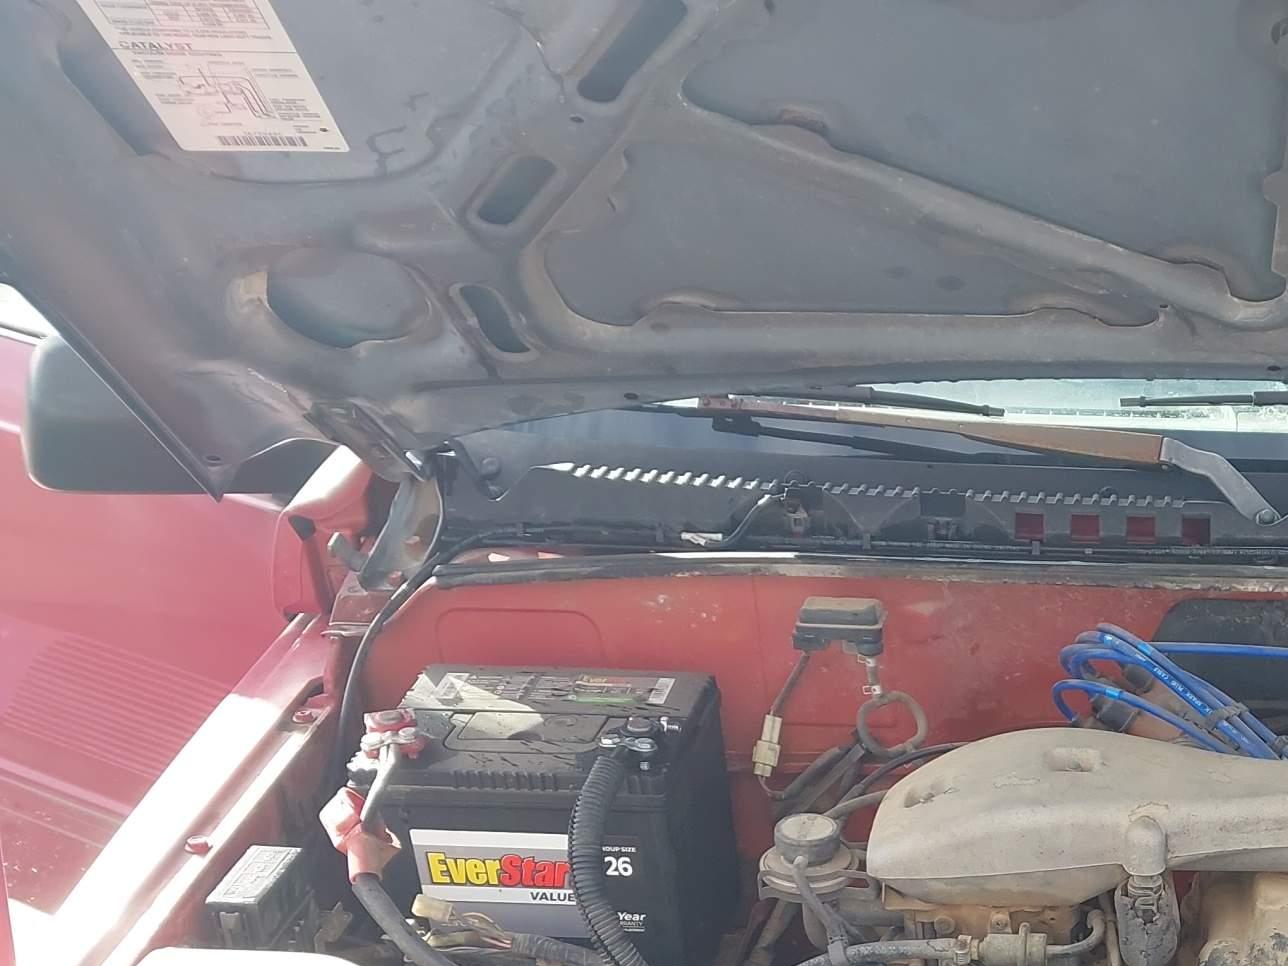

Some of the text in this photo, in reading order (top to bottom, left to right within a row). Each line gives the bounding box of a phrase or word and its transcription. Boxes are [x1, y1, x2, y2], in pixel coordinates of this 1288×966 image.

[120, 40, 193, 50] CATALYST
[426, 852, 570, 888] EverStar
[604, 856, 633, 876] 26
[530, 892, 576, 902] VALUE
[617, 912, 646, 921] Year
